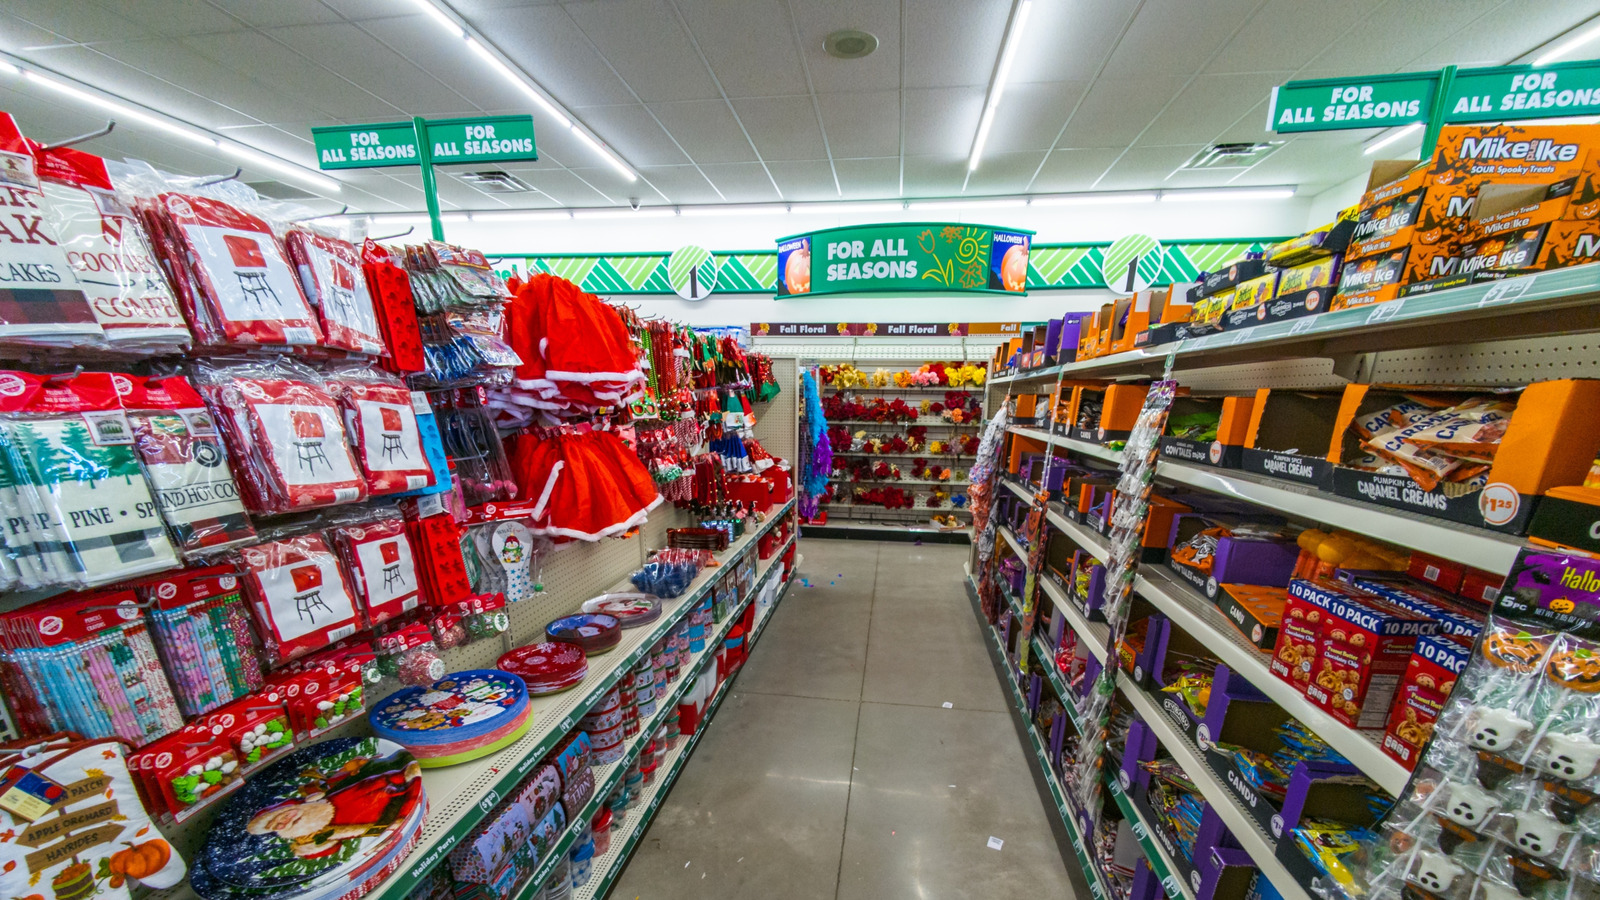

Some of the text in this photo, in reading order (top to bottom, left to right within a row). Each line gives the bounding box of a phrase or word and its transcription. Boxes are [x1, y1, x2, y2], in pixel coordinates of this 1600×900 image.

[1510, 72, 1558, 92] FOR
[1331, 86, 1374, 104] FOR
[1452, 87, 1600, 114] ALL SEASONS
[1278, 100, 1421, 125] ALL SEASONS
[350, 132, 380, 147] FOR
[465, 125, 496, 140] FOR
[322, 145, 416, 163] ALL SEASONS
[434, 138, 533, 157] ALL SEASONS
[1459, 137, 1529, 159] Mike
[1535, 140, 1579, 162] Ike
[1471, 165, 1555, 175] SOUR Spooky Treats
[1496, 209, 1519, 221] Spooky
[1520, 204, 1540, 214] Treats
[1357, 217, 1387, 237] Mike
[1388, 212, 1410, 228] Ike
[1484, 217, 1530, 234] Mike Ike
[993, 234, 1023, 245] HALLOWEEN
[827, 238, 908, 261] FOR ALL
[826, 260, 918, 282] SEASONS
[1458, 254, 1497, 274] Mike
[1499, 250, 1528, 267] Ike
[1342, 268, 1394, 288] Mike Ike
[780, 325, 826, 334] Fall Floral
[888, 325, 937, 334] Fall Floral
[1000, 324, 1016, 332] Fall
[1385, 411, 1461, 452] CARAMEL
[1264, 459, 1313, 478] CARAMEL CREAMS
[1373, 475, 1404, 488] PUMPKIN
[186, 486, 213, 505] HOT
[1357, 480, 1447, 511] CARAMEL CREAMS
[68, 506, 114, 529] PINE
[1291, 583, 1331, 609] 10 PACK
[1332, 602, 1380, 632] 10 PACK
[1385, 622, 1440, 635] 10 PACK
[1327, 645, 1359, 661] Peanut Butter
[1419, 641, 1435, 659] 10
[1347, 658, 1359, 669] Chip
[1411, 692, 1430, 706] Peanut
[518, 745, 546, 774] Holiday Party
[70, 779, 104, 796] PATCH
[1227, 770, 1257, 808] CANDY
[28, 806, 113, 842] APPLE ORCHARD
[46, 832, 98, 862] HAYRIDES
[1155, 824, 1176, 857] CANDY
[412, 834, 456, 878] Holiday Party
[534, 853, 559, 887] Holiday Party
